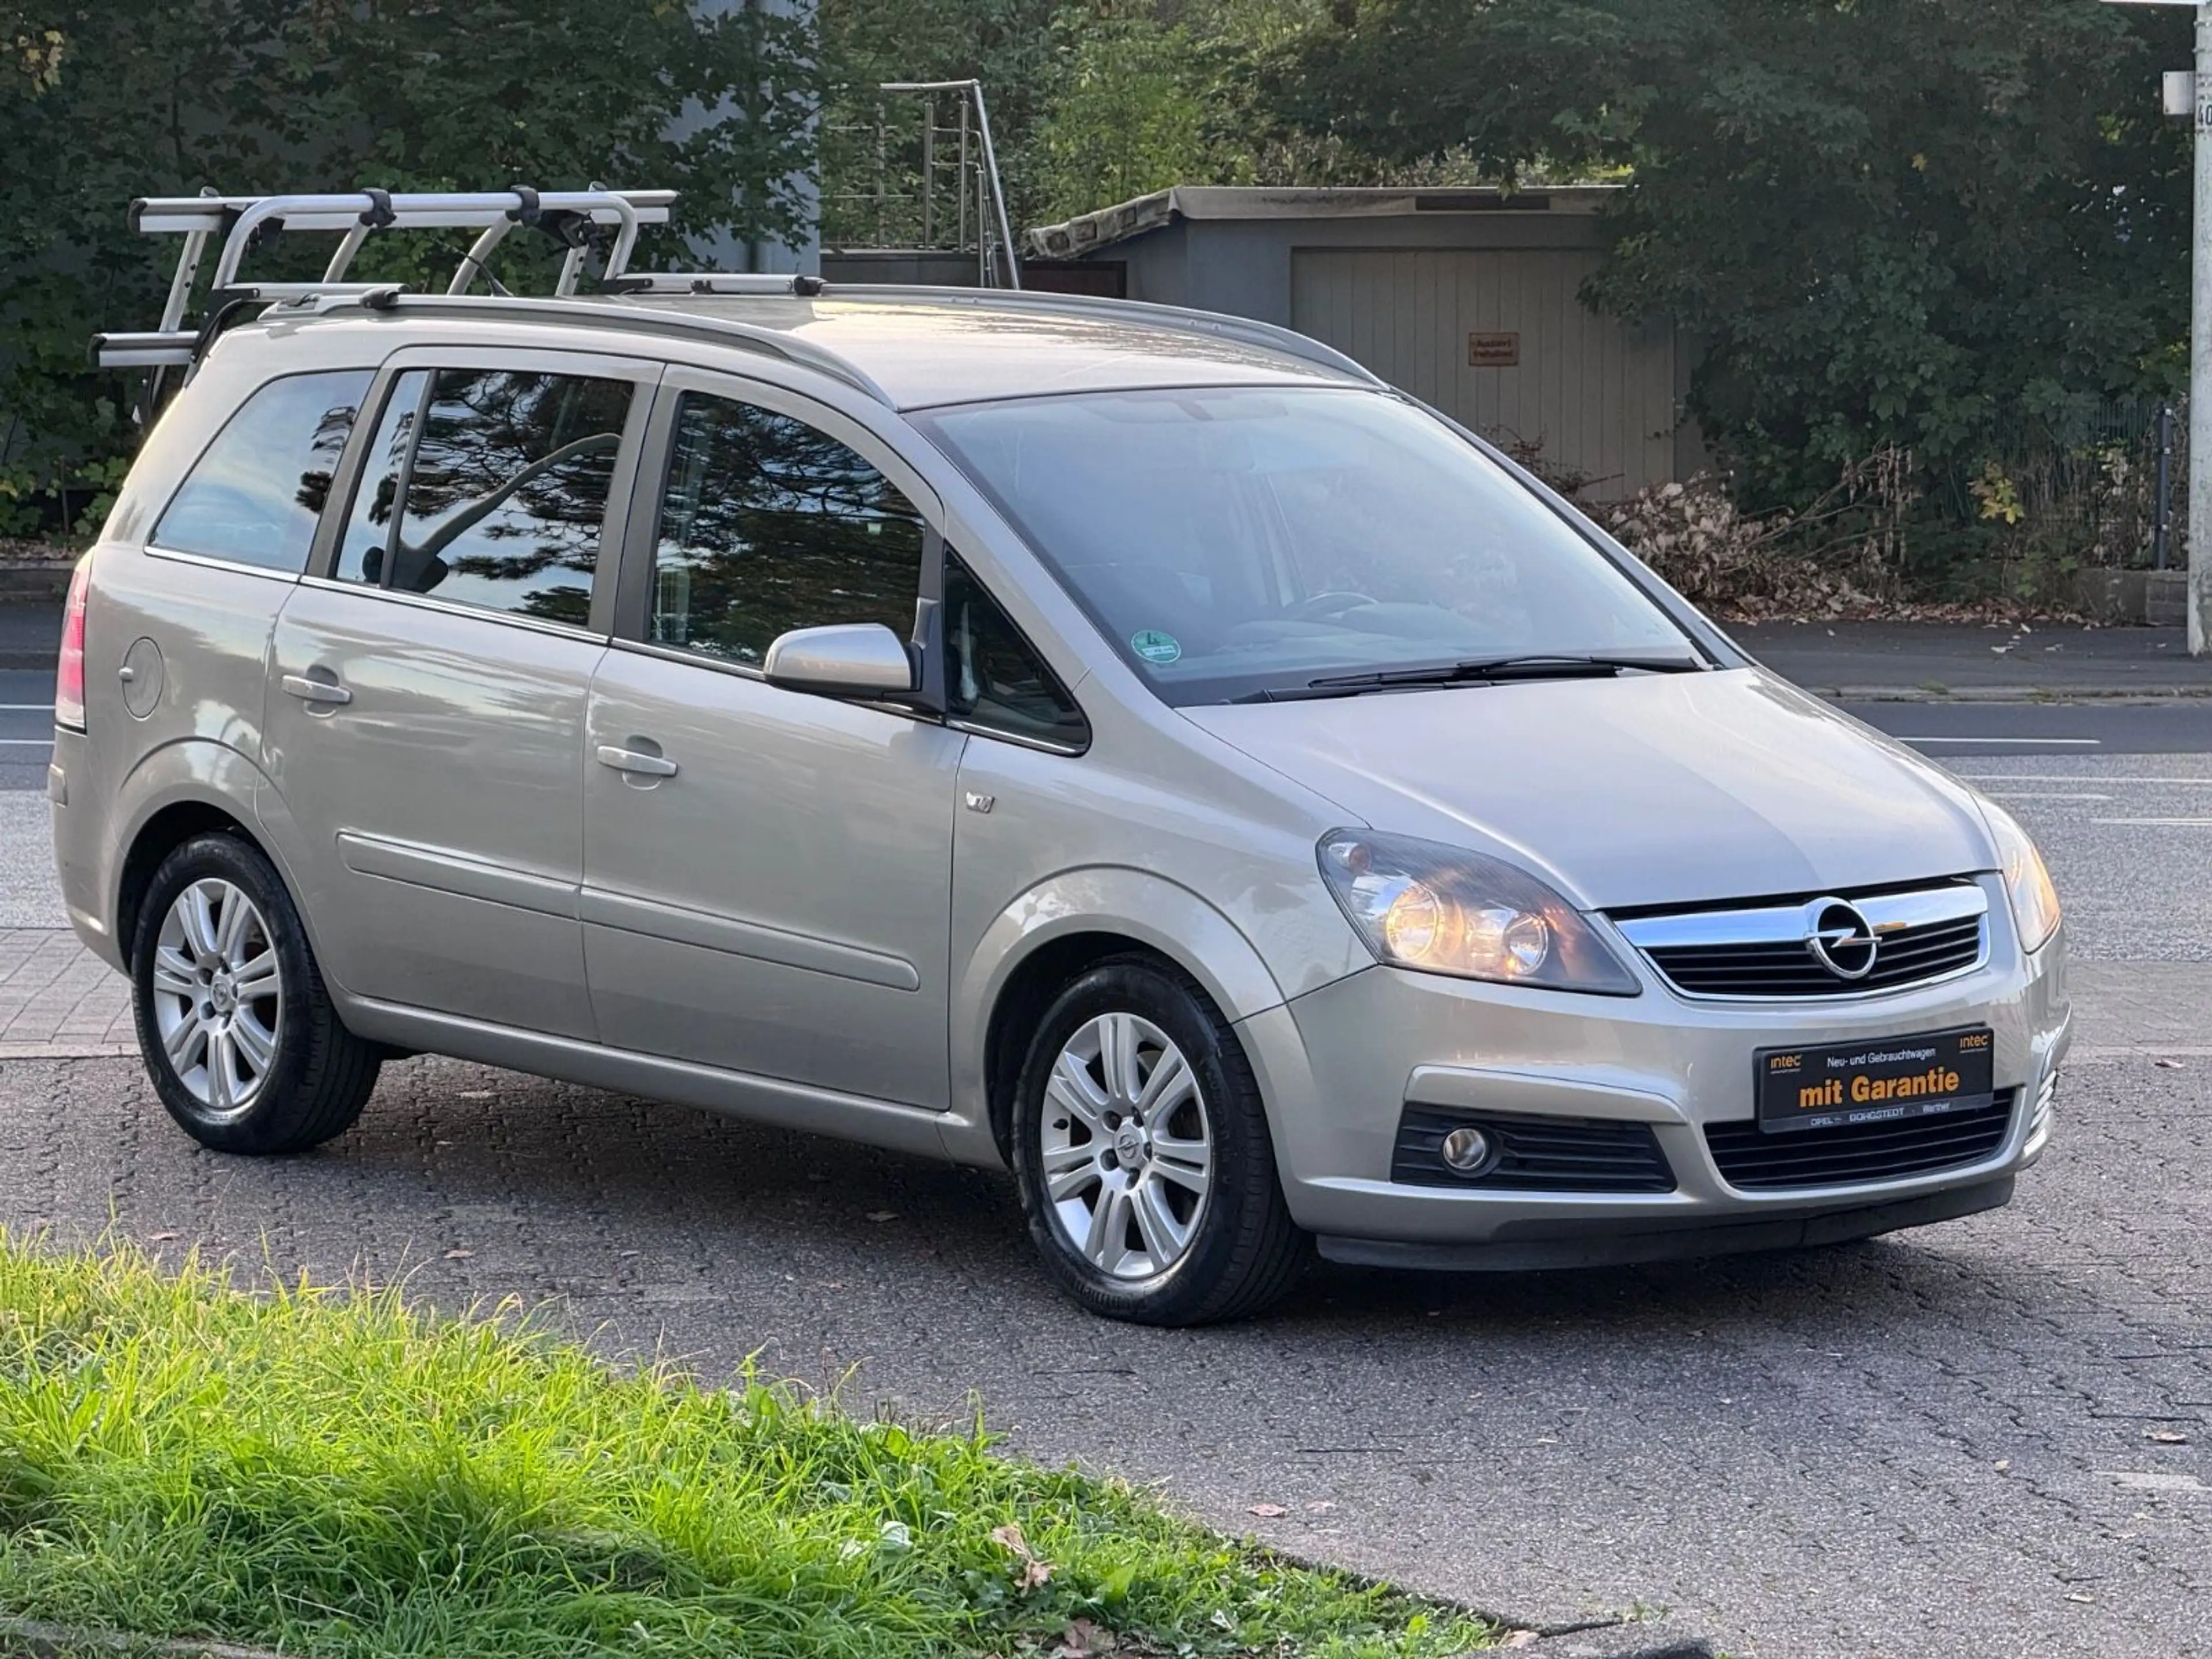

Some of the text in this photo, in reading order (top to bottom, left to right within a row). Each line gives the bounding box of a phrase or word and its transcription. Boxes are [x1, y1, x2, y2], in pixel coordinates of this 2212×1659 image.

[1827, 1047, 1936, 1068] Neu- und Gebrauchtwagen
[1800, 1067, 1960, 1107] mit Garantie
